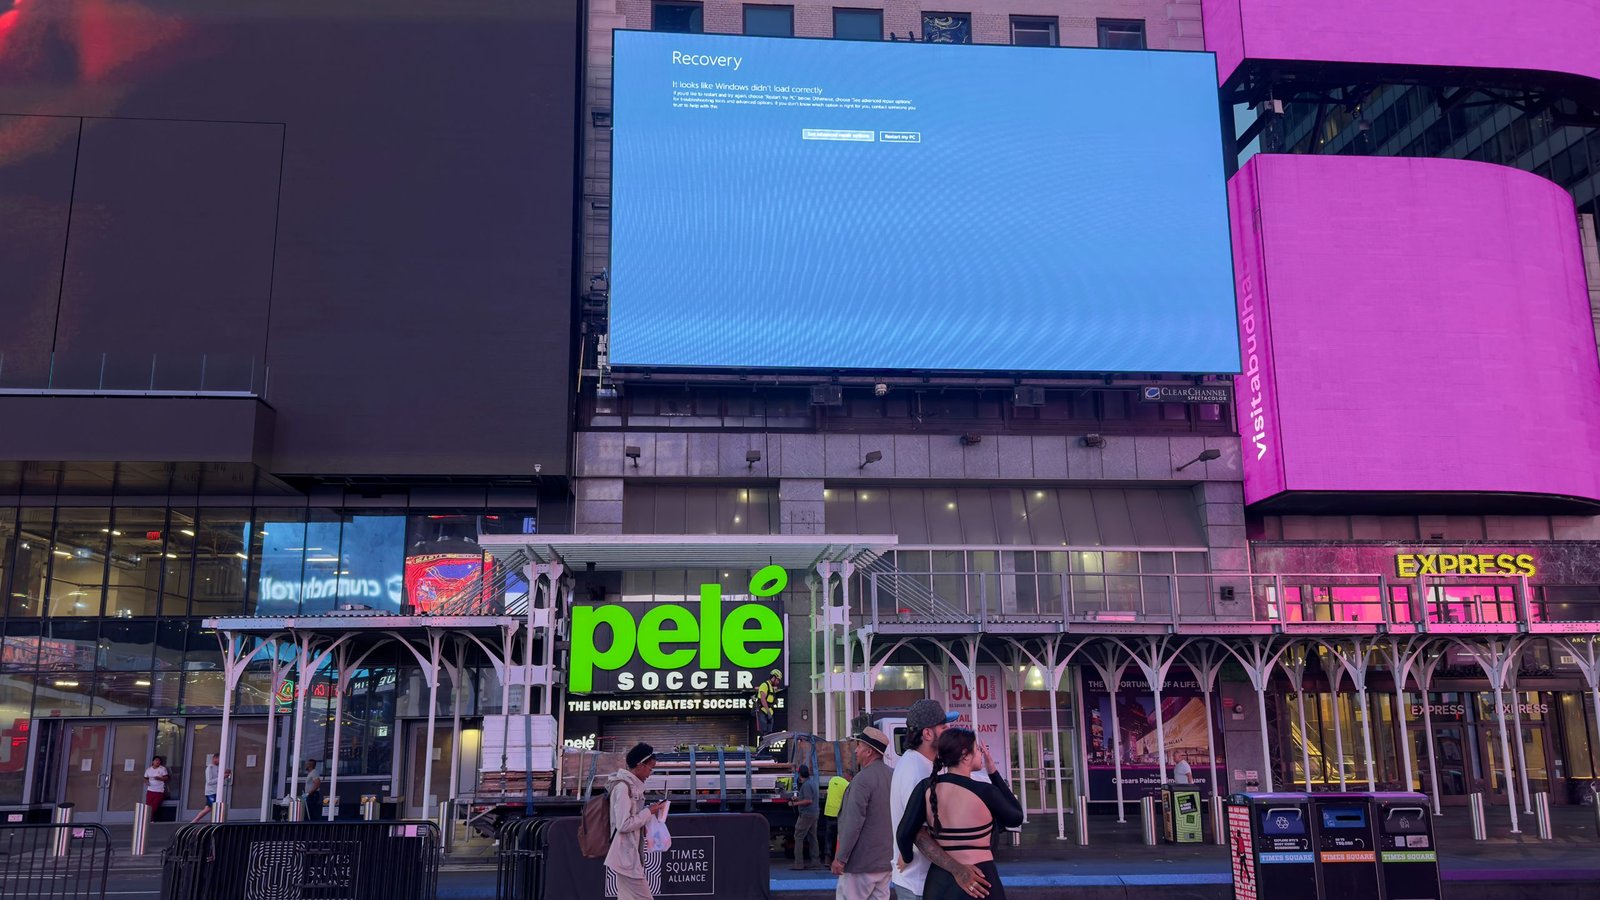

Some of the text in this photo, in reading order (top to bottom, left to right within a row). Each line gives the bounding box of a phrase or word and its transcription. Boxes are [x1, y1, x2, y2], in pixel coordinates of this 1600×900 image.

[672, 50, 743, 71] Recovery
[672, 80, 823, 96] It looks like Windows didn't load correctly
[1395, 553, 1536, 578] EXPRESS
[569, 565, 789, 693] pelé
[617, 670, 754, 691] SOCCER
[1173, 680, 1180, 688] A
[567, 700, 592, 712] THE
[592, 699, 642, 711] WORLD'S
[642, 699, 701, 711] GREATEST
[702, 698, 747, 710] SOCCER
[1111, 777, 1139, 785] Cesars
[1139, 777, 1161, 785] Palace
[670, 849, 705, 860] TIMES
[1322, 852, 1374, 861] TIMES SQUARE
[1383, 852, 1435, 861] TIMES SQUARE
[666, 861, 709, 874] SQUARE
[668, 874, 707, 883] ALLIANCE
